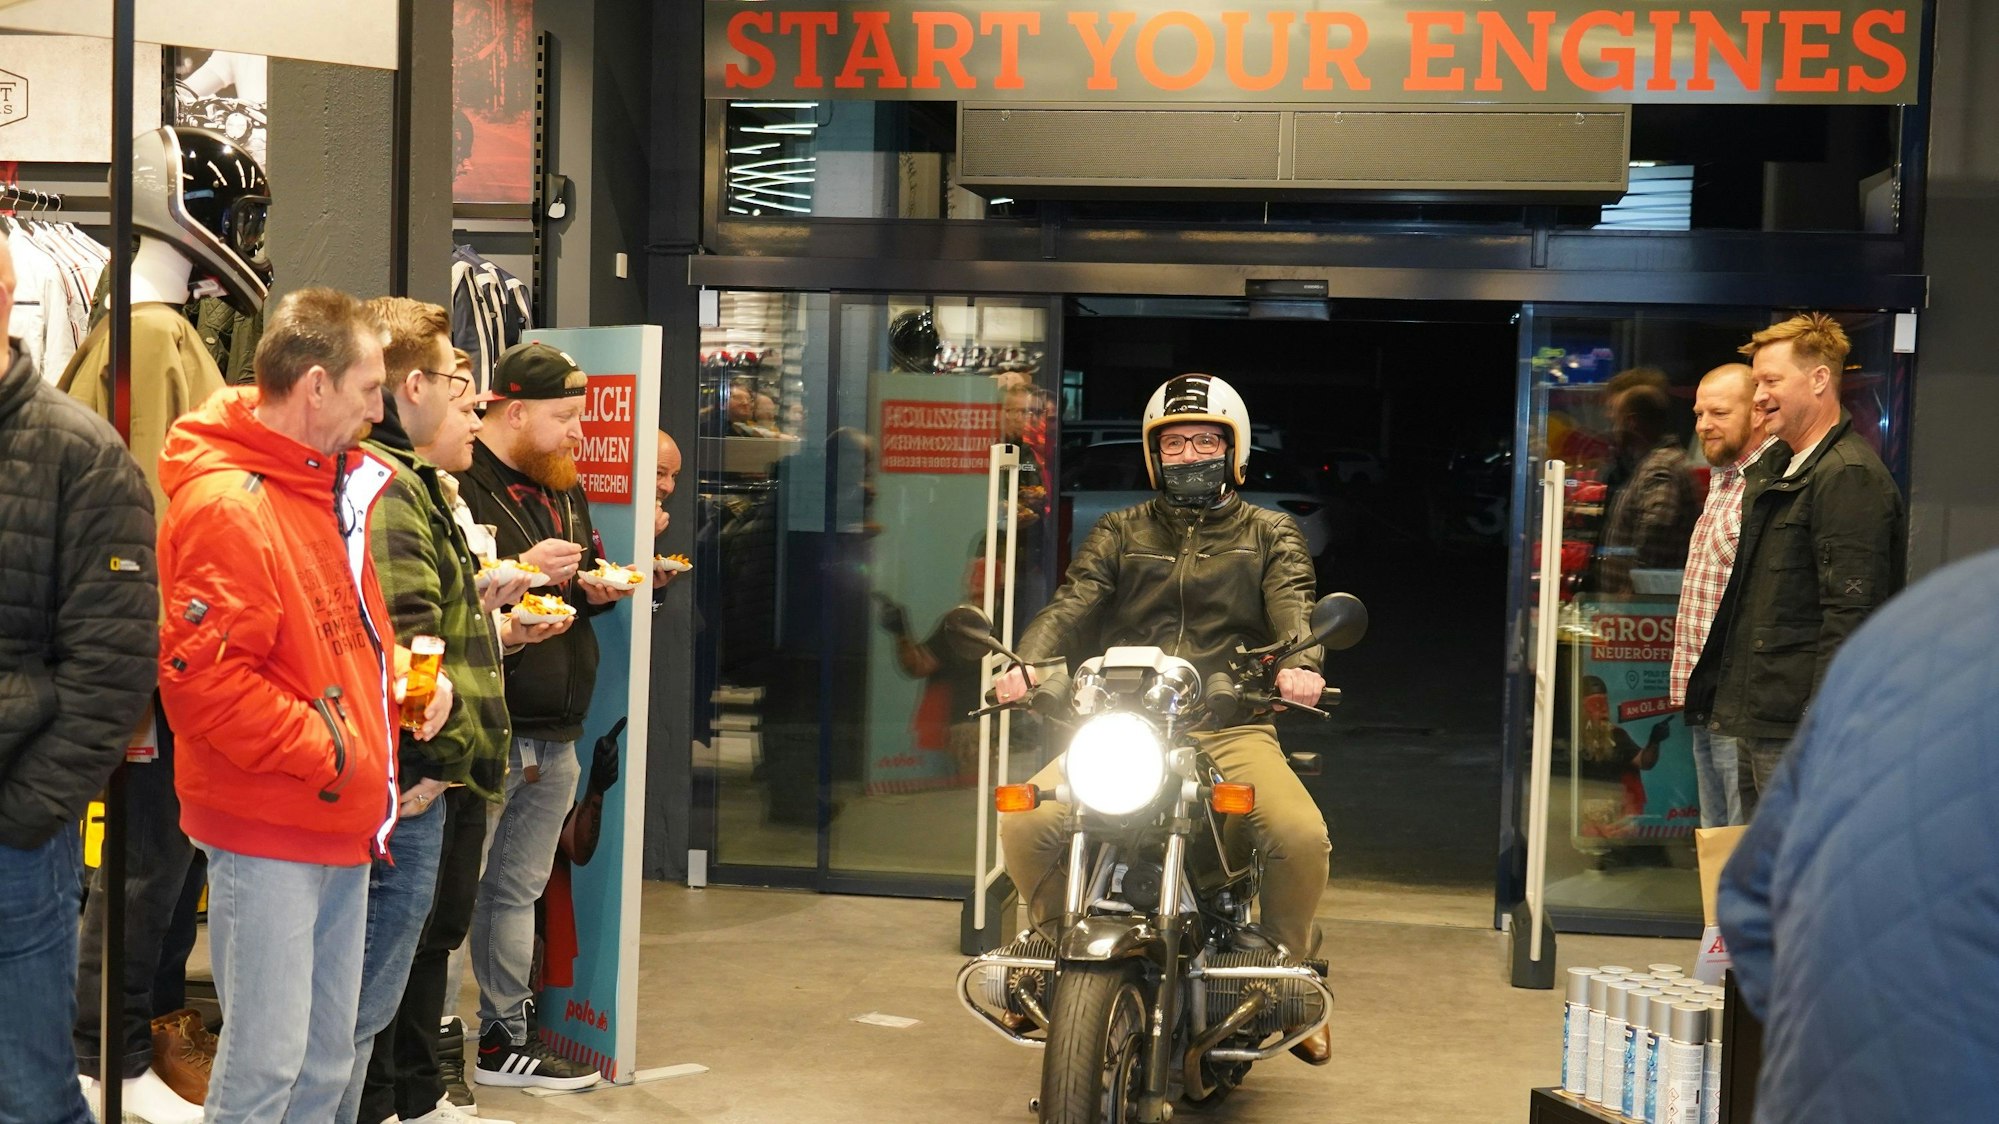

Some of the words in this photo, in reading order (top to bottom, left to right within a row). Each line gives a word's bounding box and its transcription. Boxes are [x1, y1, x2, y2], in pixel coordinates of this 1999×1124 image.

[725, 11, 1041, 89] START
[1066, 10, 1372, 92] YOUR
[1403, 9, 1908, 93] ENGINES
[589, 474, 628, 493] FRECHEN
[1599, 617, 1675, 642] GROS
[564, 999, 595, 1026] polo
